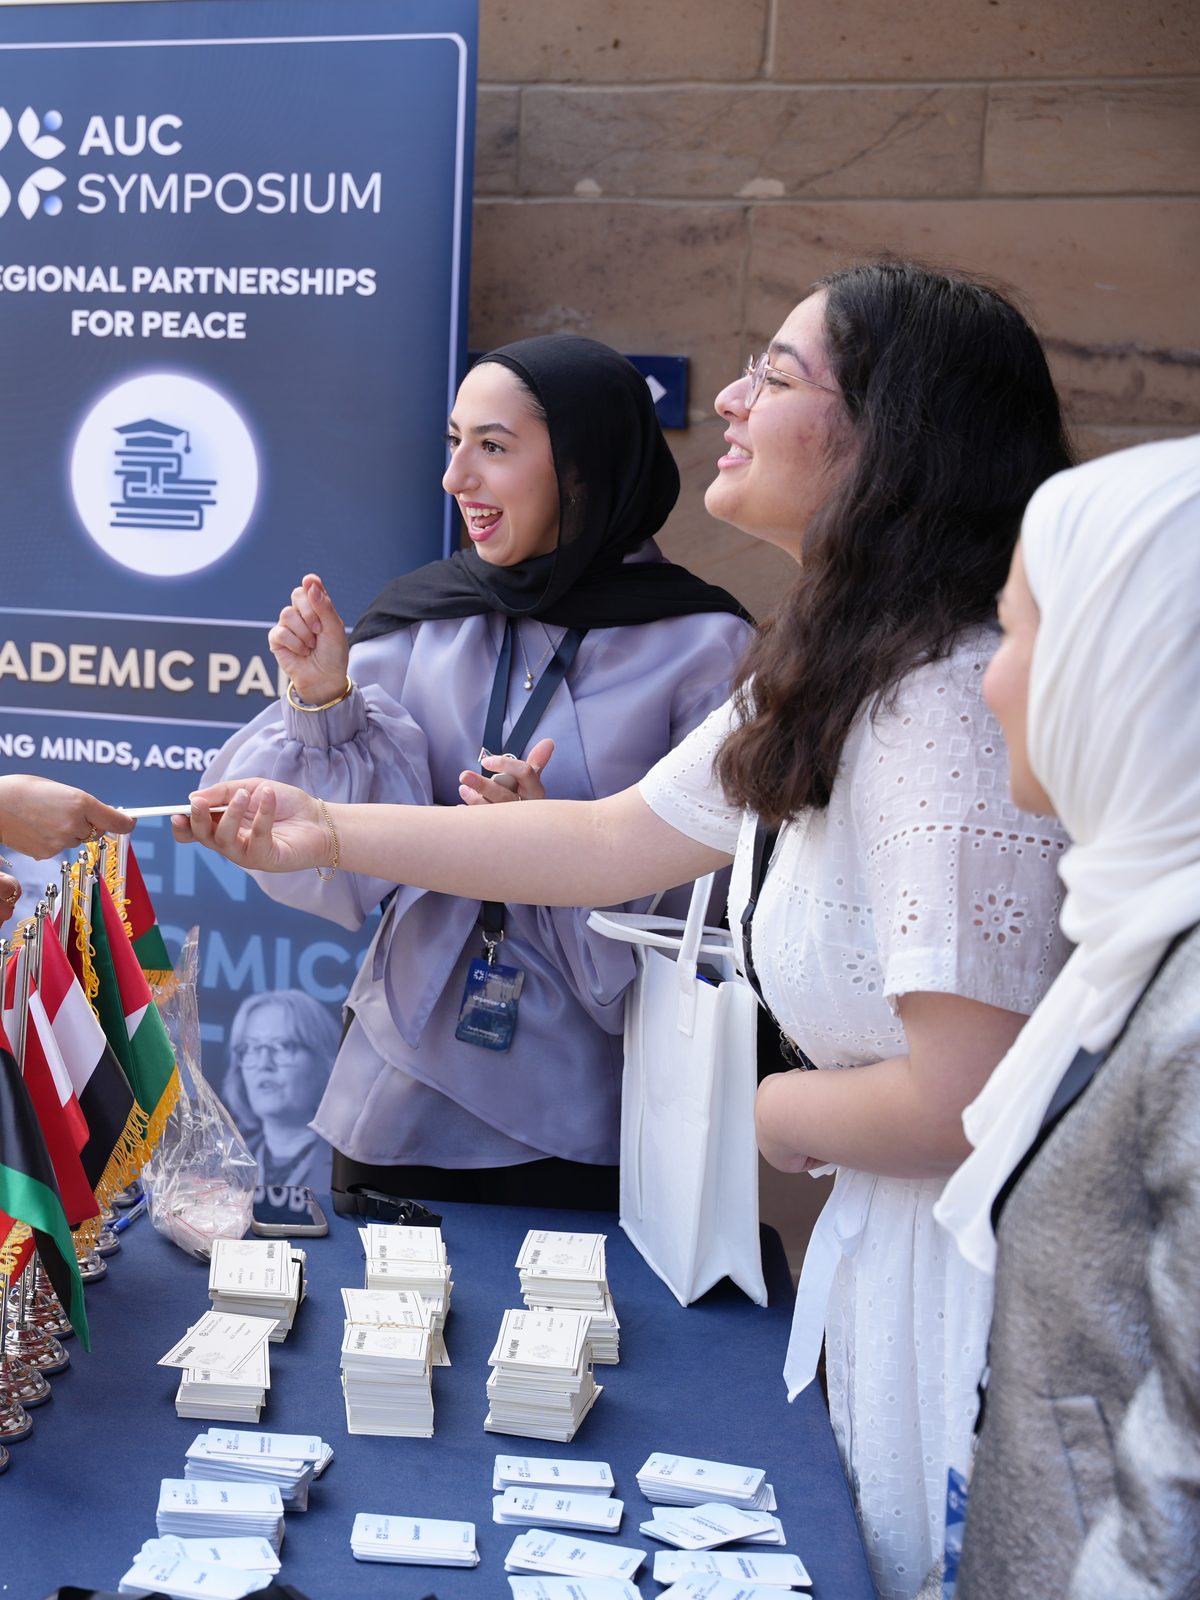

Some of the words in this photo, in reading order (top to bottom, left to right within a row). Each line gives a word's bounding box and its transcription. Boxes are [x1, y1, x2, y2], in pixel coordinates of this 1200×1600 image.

[78, 113, 184, 157] AUC
[76, 171, 382, 215] SYMPOSIUM
[132, 265, 377, 297] PARTNERSHIPS
[71, 309, 135, 338] FOR
[141, 310, 247, 340] PEACE
[40, 735, 141, 772] MINDS,
